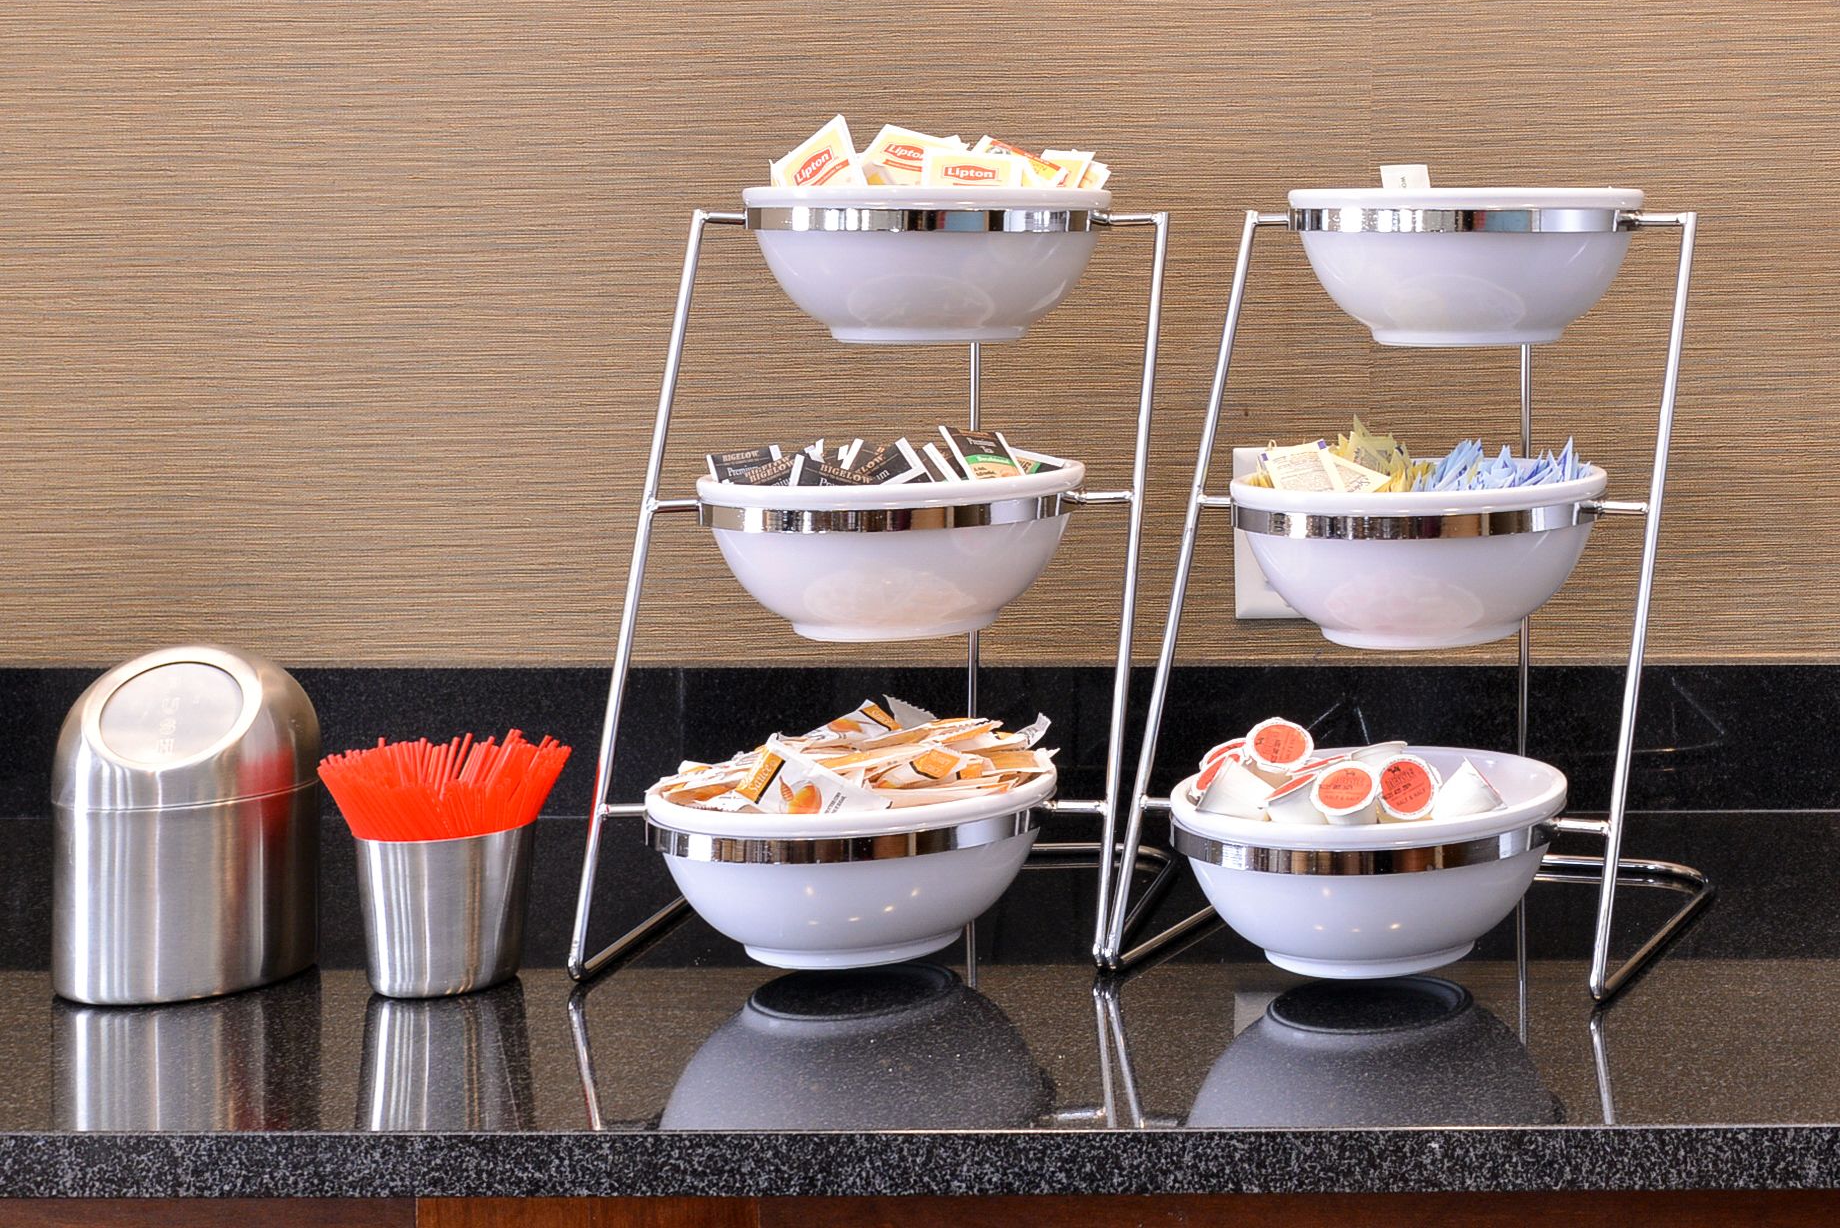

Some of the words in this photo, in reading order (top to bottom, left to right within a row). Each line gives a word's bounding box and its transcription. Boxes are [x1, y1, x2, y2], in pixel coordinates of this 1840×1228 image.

[888, 143, 924, 159] Lipto
[796, 153, 831, 183] Lipton
[947, 167, 993, 178] Lipton
[722, 450, 759, 462] BIGELOW
[820, 463, 873, 484] BIGELOW
[748, 763, 773, 792] Sauce
